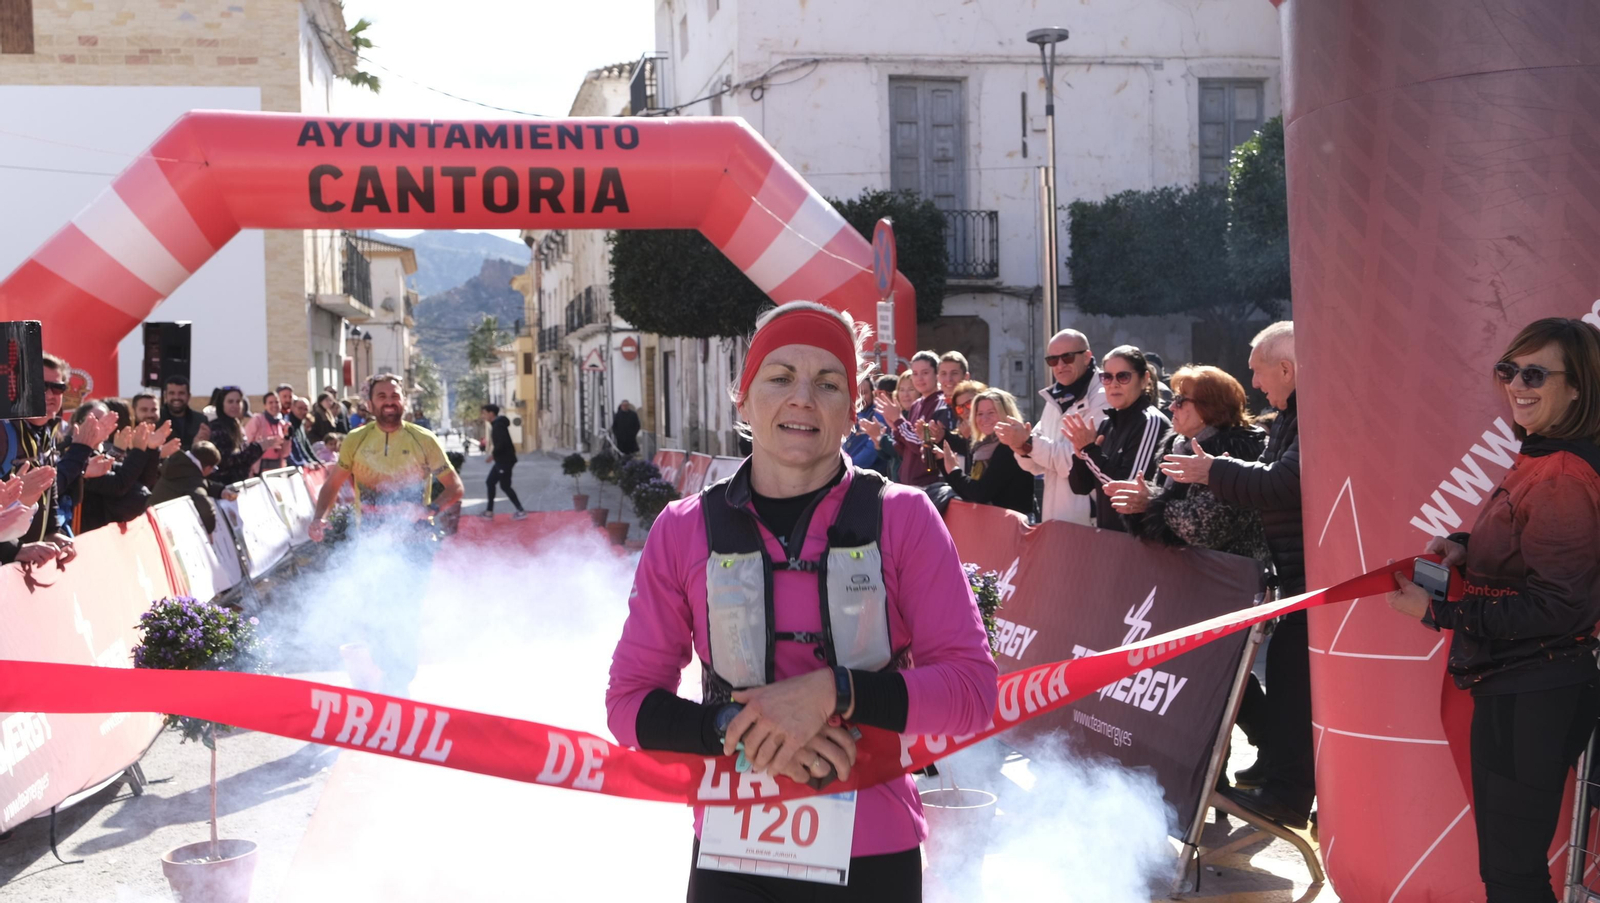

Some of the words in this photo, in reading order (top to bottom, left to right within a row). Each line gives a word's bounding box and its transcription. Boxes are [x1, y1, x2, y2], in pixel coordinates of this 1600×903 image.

[297, 120, 640, 150] AYUNTAMIENTO
[308, 164, 631, 214] CANTORIA
[311, 688, 452, 762] TRAIL
[536, 731, 609, 791] DE
[697, 758, 780, 800] LA
[734, 801, 819, 848] 120
